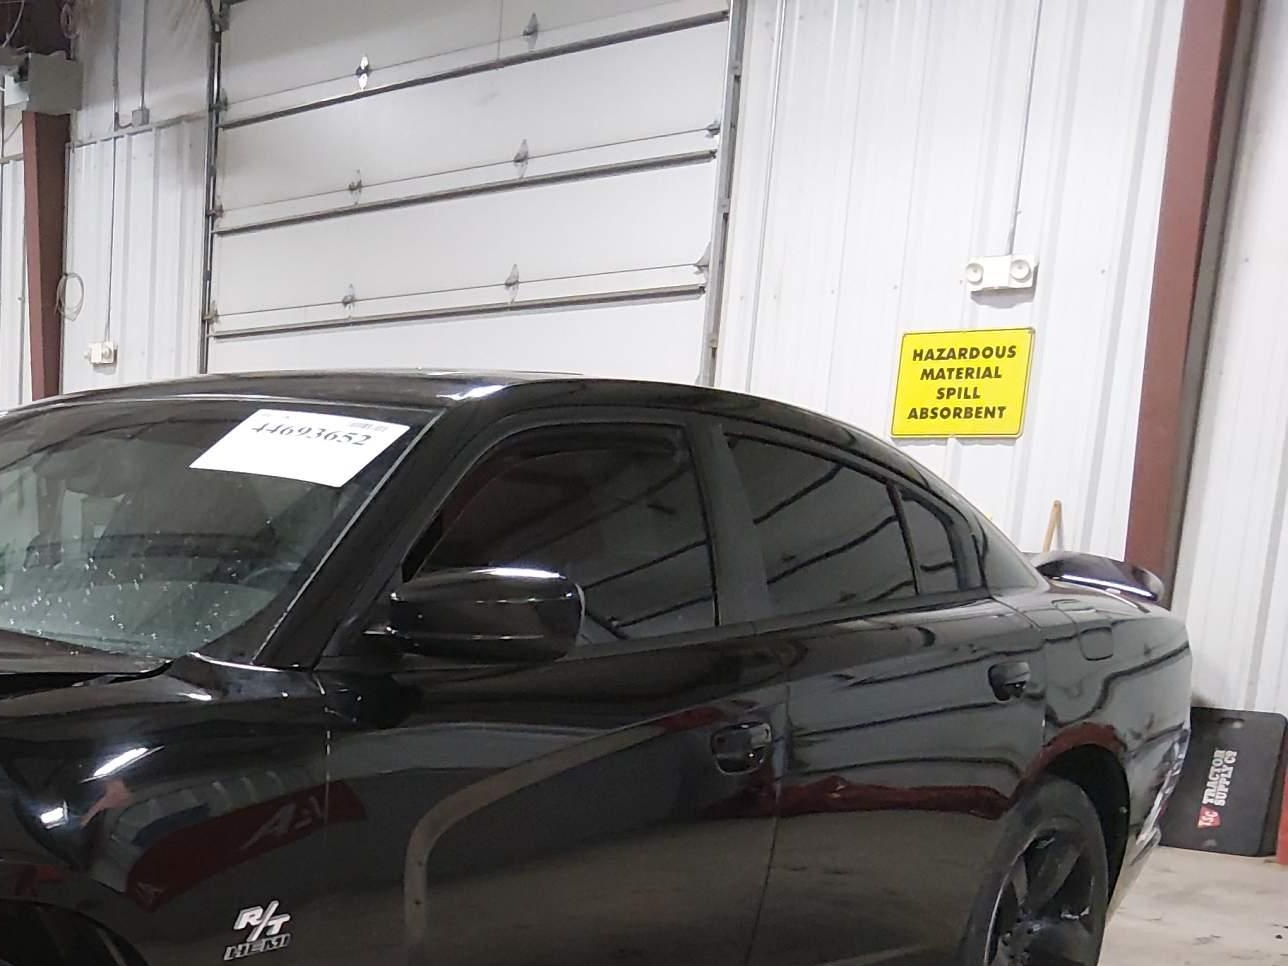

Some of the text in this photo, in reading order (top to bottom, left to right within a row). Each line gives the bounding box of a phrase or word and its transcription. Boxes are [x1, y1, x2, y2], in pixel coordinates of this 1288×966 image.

[912, 345, 1017, 361] HAZARDOUS
[920, 366, 1002, 380] MATERIAL
[936, 387, 981, 400] SPILL
[907, 406, 1007, 420] ABSORBENT
[251, 422, 372, 446] 44693652
[1202, 750, 1225, 805] TRACTOR
[1214, 764, 1233, 806] SUPPLY
[233, 900, 291, 942] R/T
